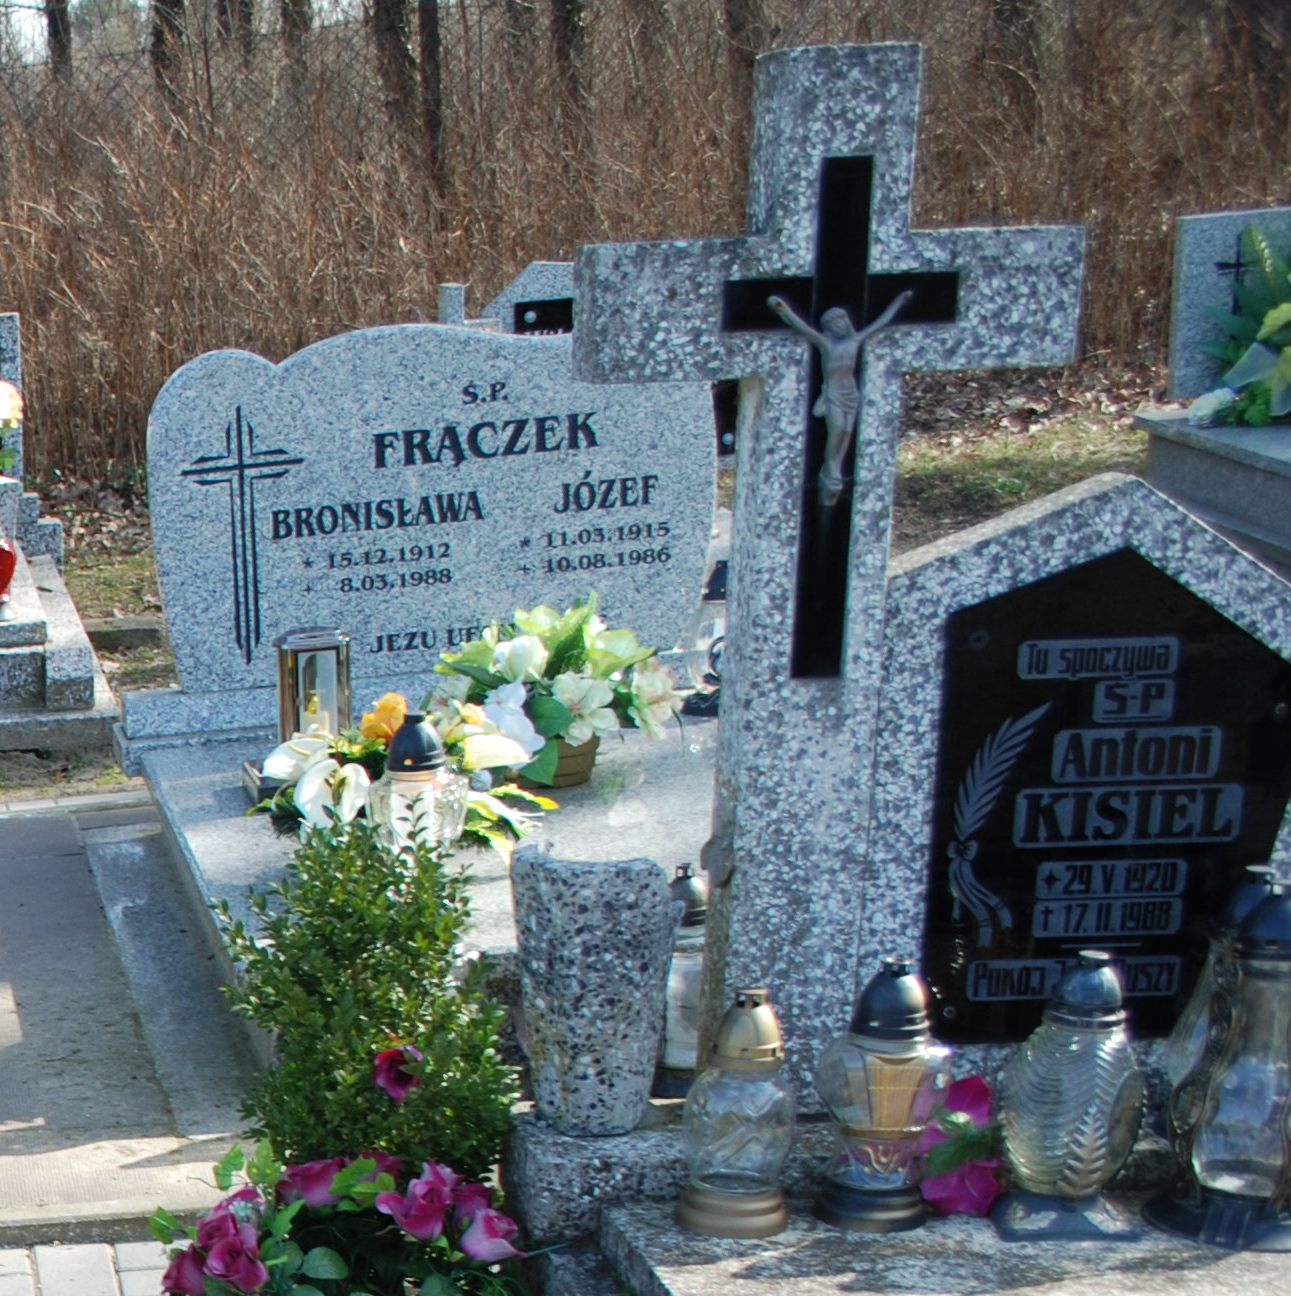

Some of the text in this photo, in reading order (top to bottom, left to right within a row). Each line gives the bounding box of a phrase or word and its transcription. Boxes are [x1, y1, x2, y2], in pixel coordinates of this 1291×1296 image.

[373, 412, 599, 469] FRĄCZEK
[272, 490, 484, 540] BRONISŁAWA
[554, 470, 659, 515] JÓZEF
[329, 542, 451, 569] 15.12.1912
[545, 547, 671, 573] 10.08.1986
[370, 629, 437, 654] JEZU
[1027, 643, 1170, 678] Tu spoczywa
[1058, 726, 1213, 781] Antoni
[1020, 787, 1234, 846] KISIEL
